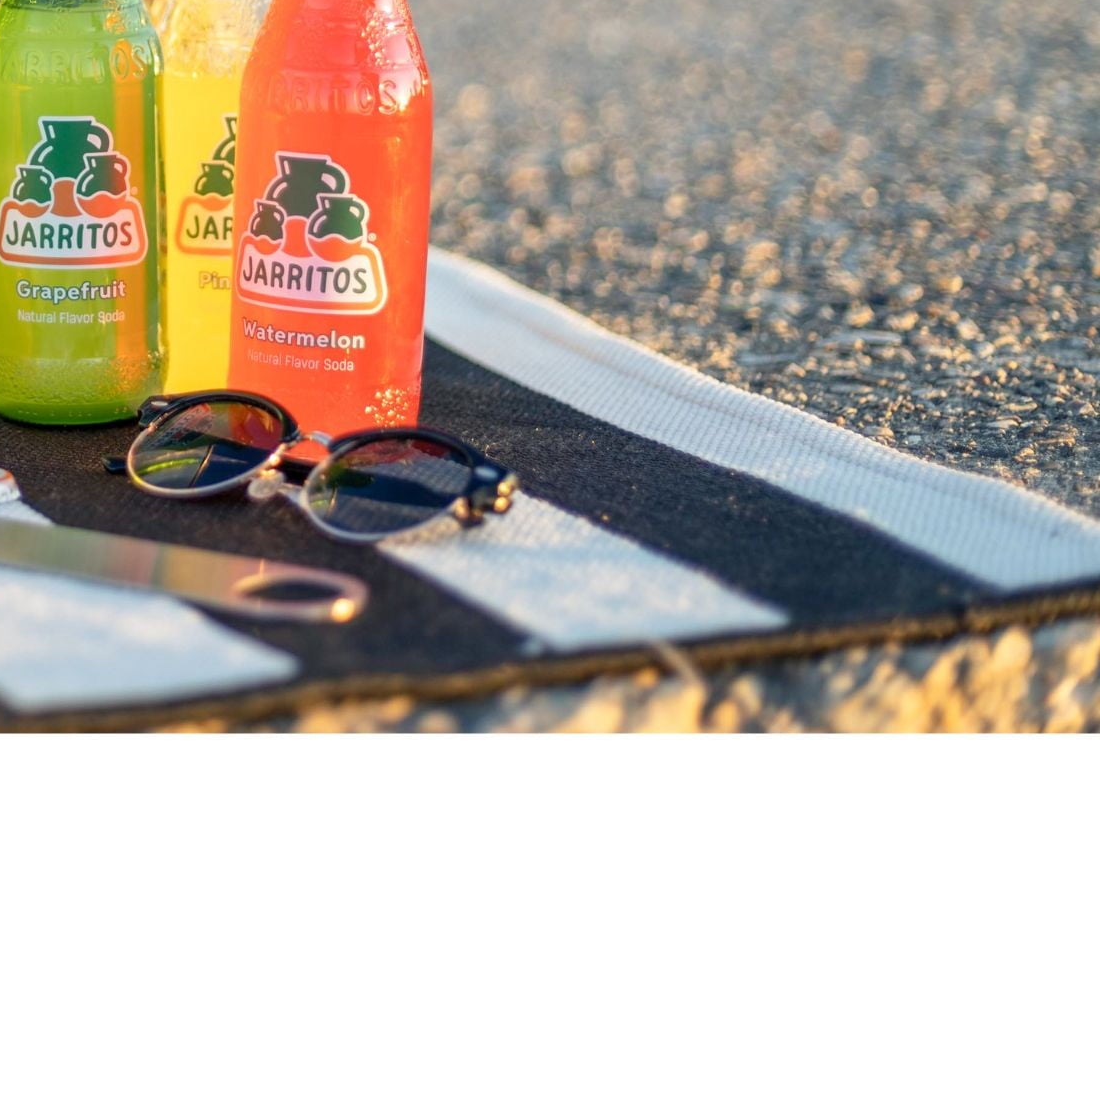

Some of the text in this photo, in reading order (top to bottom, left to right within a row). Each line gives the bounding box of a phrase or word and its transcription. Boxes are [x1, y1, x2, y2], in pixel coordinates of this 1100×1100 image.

[254, 72, 398, 116] RRITOS
[5, 220, 132, 250] JARRITOS
[242, 255, 367, 294] JARRITOS
[16, 278, 126, 305] Grapefruit
[17, 309, 126, 324] Natural Flavor Soda
[242, 316, 366, 350] Watermelon
[247, 349, 355, 372] Natural Flavor Soda
